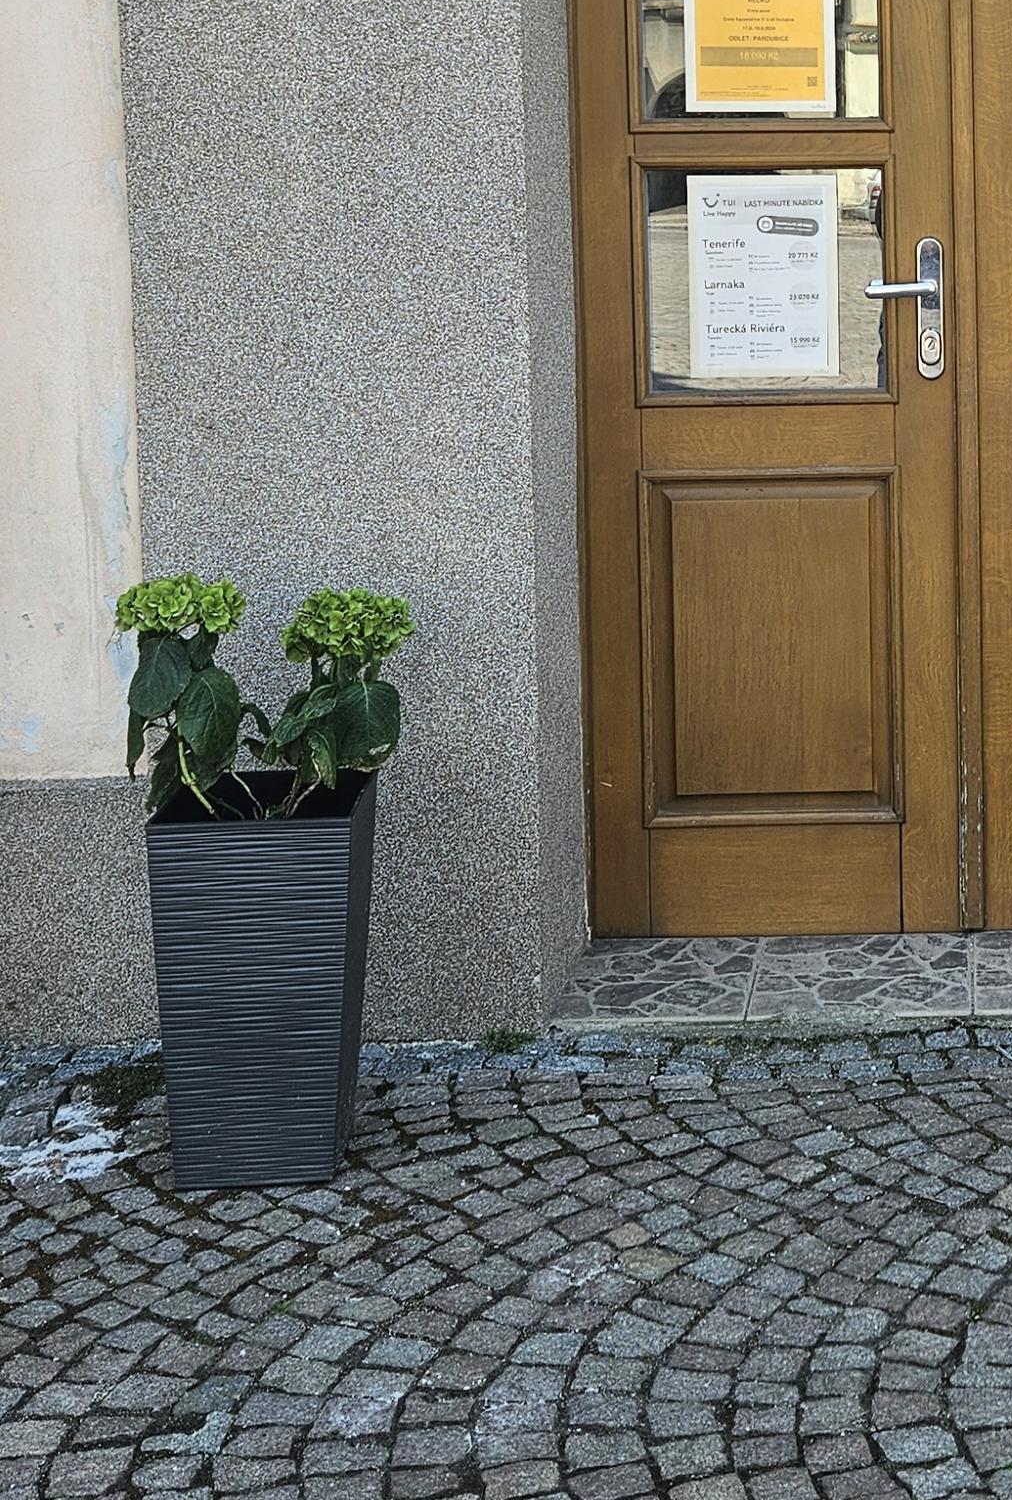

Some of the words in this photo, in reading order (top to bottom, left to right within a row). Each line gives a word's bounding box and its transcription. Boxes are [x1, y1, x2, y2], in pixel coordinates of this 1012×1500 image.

[745, 200, 761, 208] LAST
[764, 200, 790, 208] MINUTE
[793, 199, 824, 207] NABÍDKA
[717, 211, 736, 219] Happy
[702, 239, 746, 249] Tenerife
[704, 279, 745, 289] Larnaka
[706, 324, 747, 334] Turecká
[750, 323, 785, 333] Riviéra
